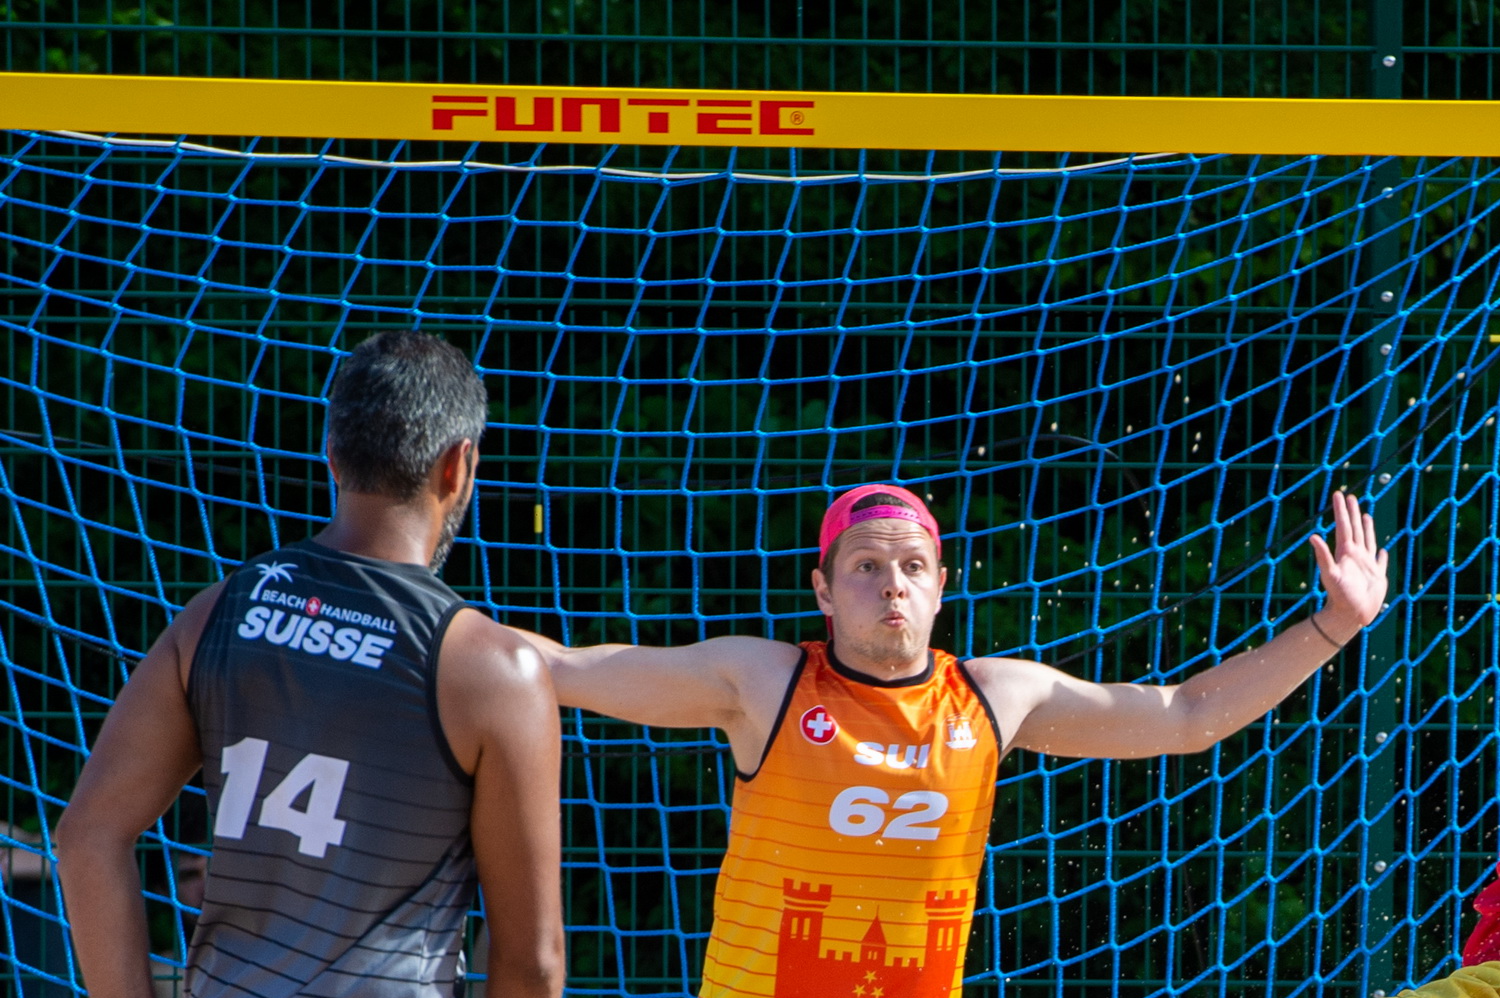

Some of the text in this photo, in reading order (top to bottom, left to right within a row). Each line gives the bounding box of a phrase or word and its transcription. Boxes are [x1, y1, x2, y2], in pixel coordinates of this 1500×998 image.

[237, 606, 394, 669] SUISSE
[261, 589, 397, 634] BEACH HANDBALL
[853, 741, 931, 770] SUI
[214, 737, 350, 858] 14
[828, 785, 949, 841] 62
